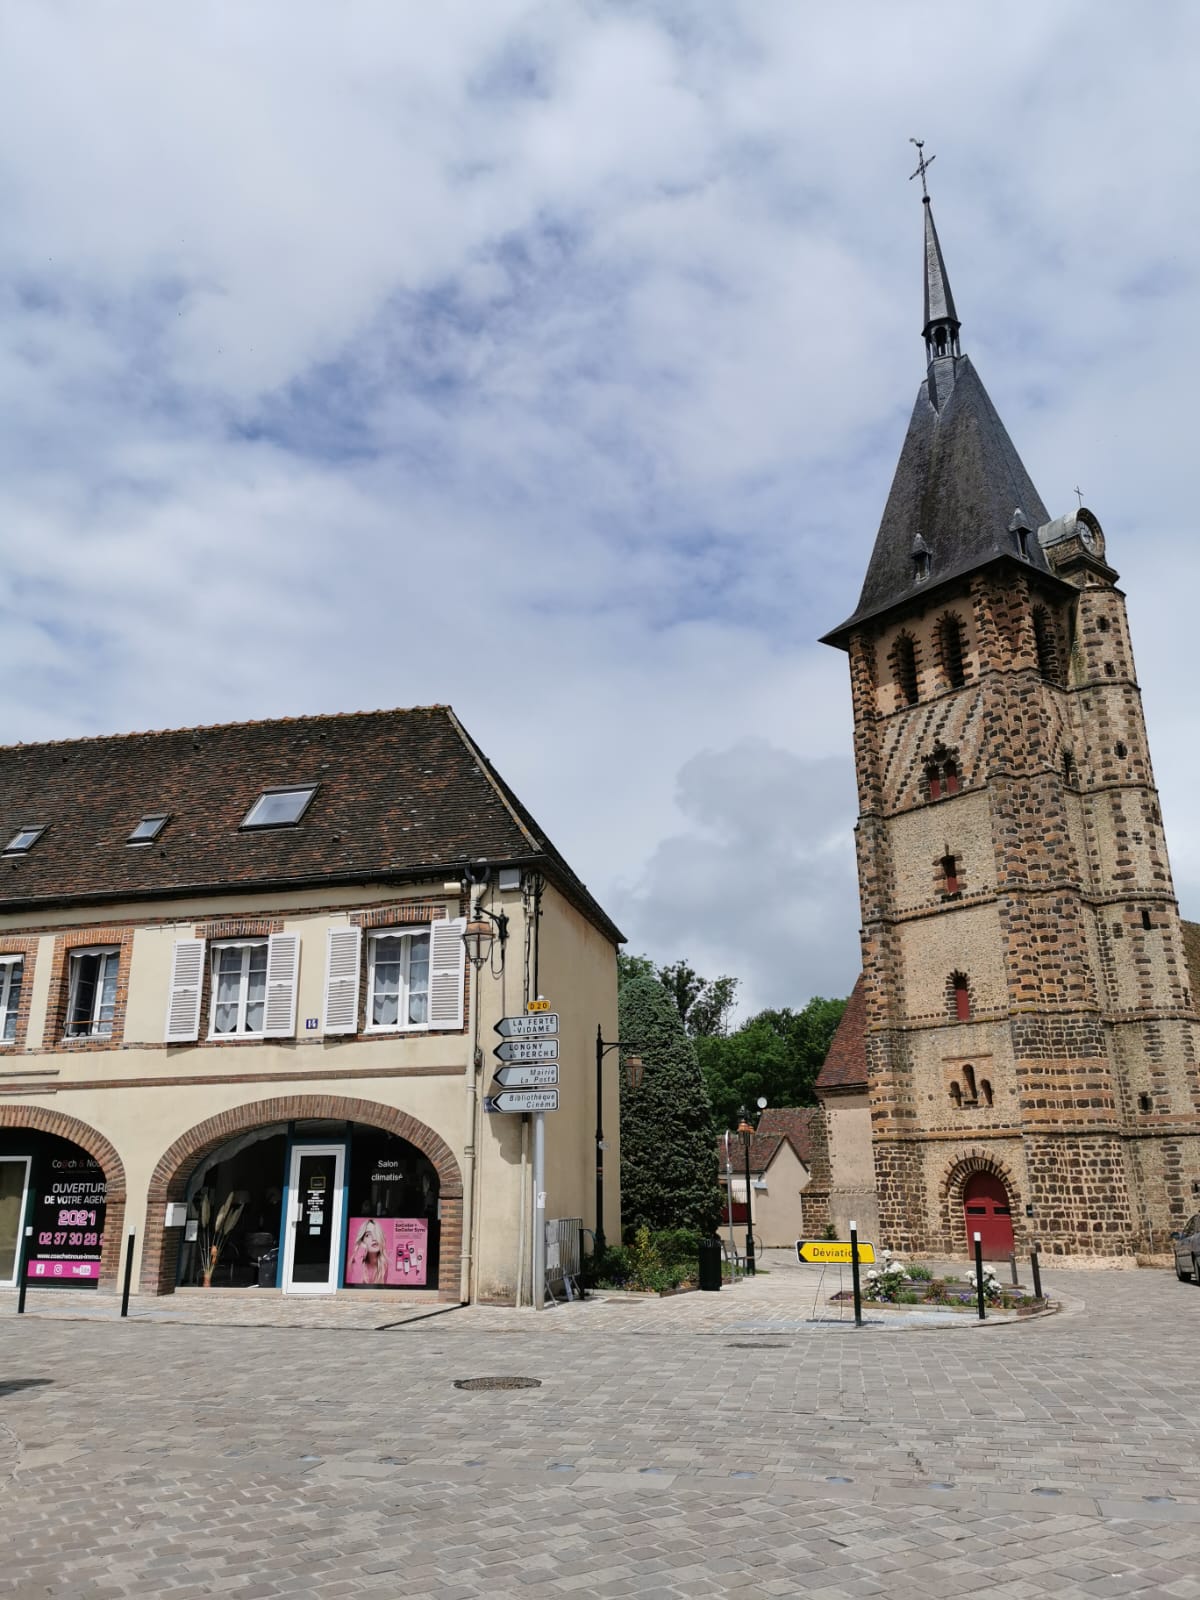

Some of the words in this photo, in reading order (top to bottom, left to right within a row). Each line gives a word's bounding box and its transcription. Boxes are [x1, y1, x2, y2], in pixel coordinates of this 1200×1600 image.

[528, 1017, 555, 1025] FERTÉ
[509, 1043, 543, 1051] LONGNY
[520, 1050, 555, 1058] PERCHE
[509, 1093, 555, 1102] Bibliothèque
[526, 1101, 555, 1109] Cinéma
[377, 1160, 399, 1168] Salon
[44, 1196, 55, 1204] DE
[57, 1195, 82, 1204] VOTRE
[83, 1195, 106, 1204] AGEN
[58, 1210, 96, 1226] 2021
[39, 1232, 52, 1245] 02
[54, 1232, 67, 1245] 37
[69, 1232, 83, 1245] 30
[84, 1232, 97, 1245] 28
[813, 1248, 854, 1257] Déviatio
